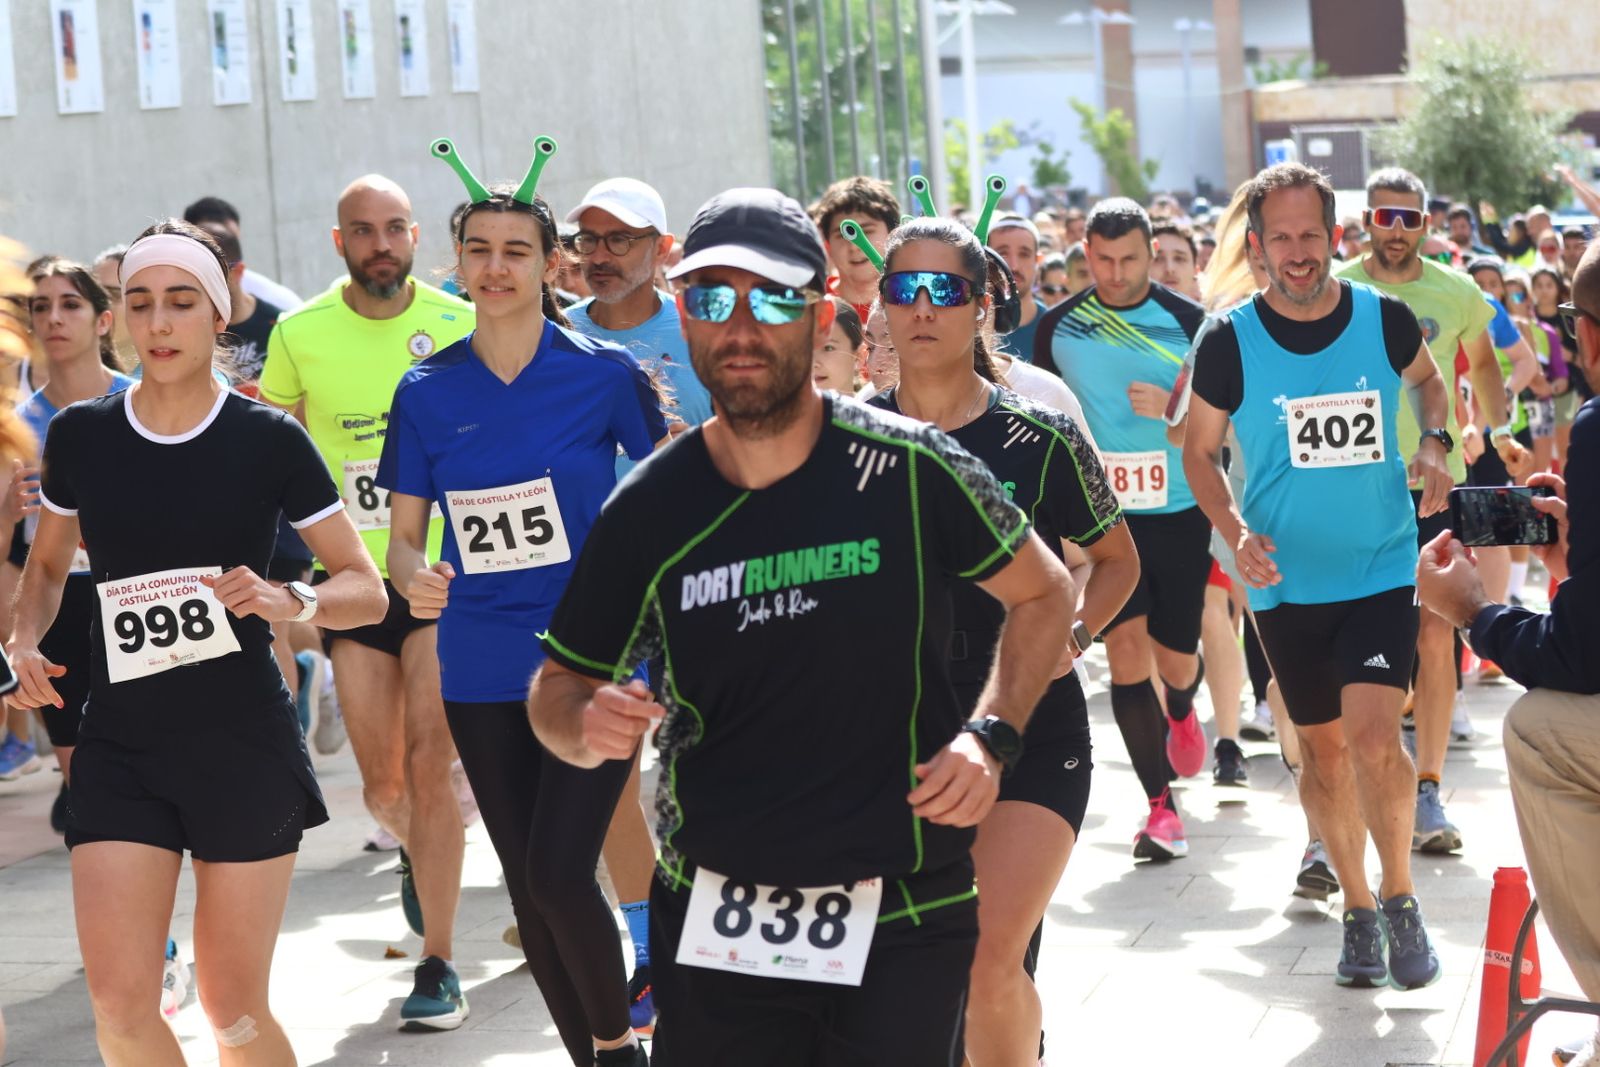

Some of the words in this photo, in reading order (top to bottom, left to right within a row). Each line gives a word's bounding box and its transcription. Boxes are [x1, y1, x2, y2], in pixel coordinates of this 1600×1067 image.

[1305, 402, 1315, 410] DE
[1316, 399, 1349, 408] CASTILLA
[1297, 413, 1376, 450] 402
[356, 464, 367, 472] DE
[355, 475, 391, 511] 8
[452, 497, 465, 506] DÍA
[466, 498, 476, 506] DE
[477, 494, 515, 504] CASTILLA
[516, 491, 521, 499] Y
[523, 486, 548, 498] LEÓN
[463, 505, 554, 553] 215
[106, 586, 120, 598] DÍA
[121, 585, 133, 595] DE
[135, 582, 147, 592] LA
[119, 592, 160, 606] CASTILLA
[162, 590, 168, 598] Y
[170, 586, 198, 597] LEÓN
[774, 593, 784, 617] &
[787, 588, 818, 619] Run
[114, 598, 215, 654] 998
[713, 879, 852, 950] 838
